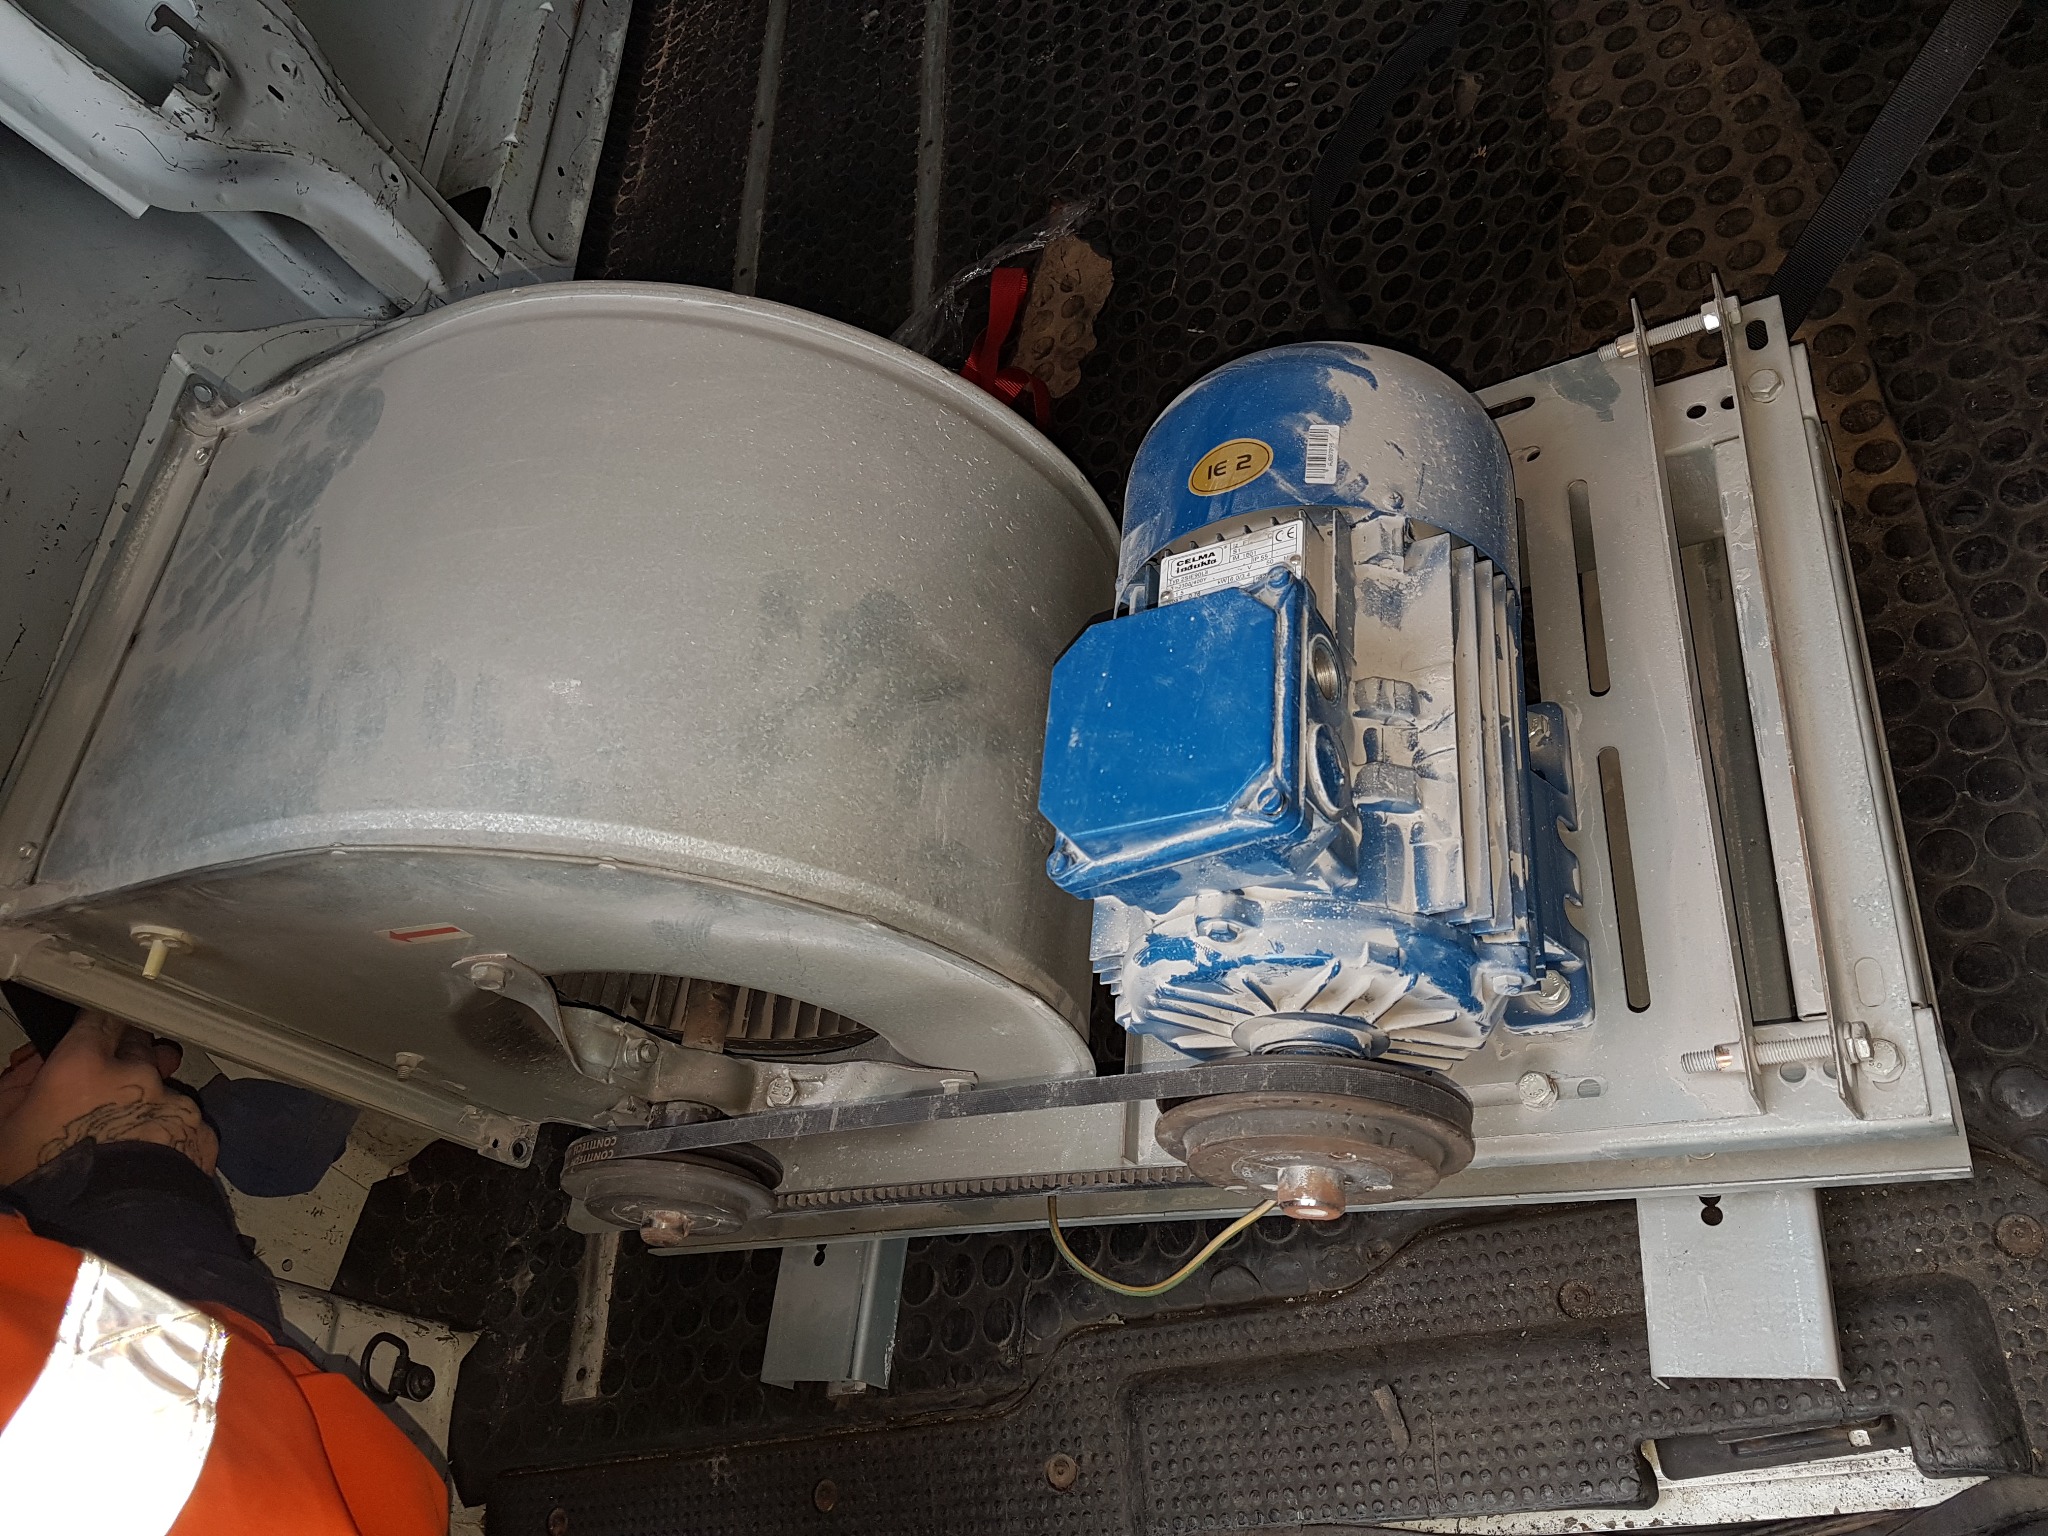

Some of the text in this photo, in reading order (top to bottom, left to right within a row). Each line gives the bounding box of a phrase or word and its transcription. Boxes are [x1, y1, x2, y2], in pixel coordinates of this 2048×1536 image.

[1207, 453, 1252, 480] IE 2
[1176, 551, 1216, 567] CELMA
[573, 1136, 617, 1155] CONTITECH
